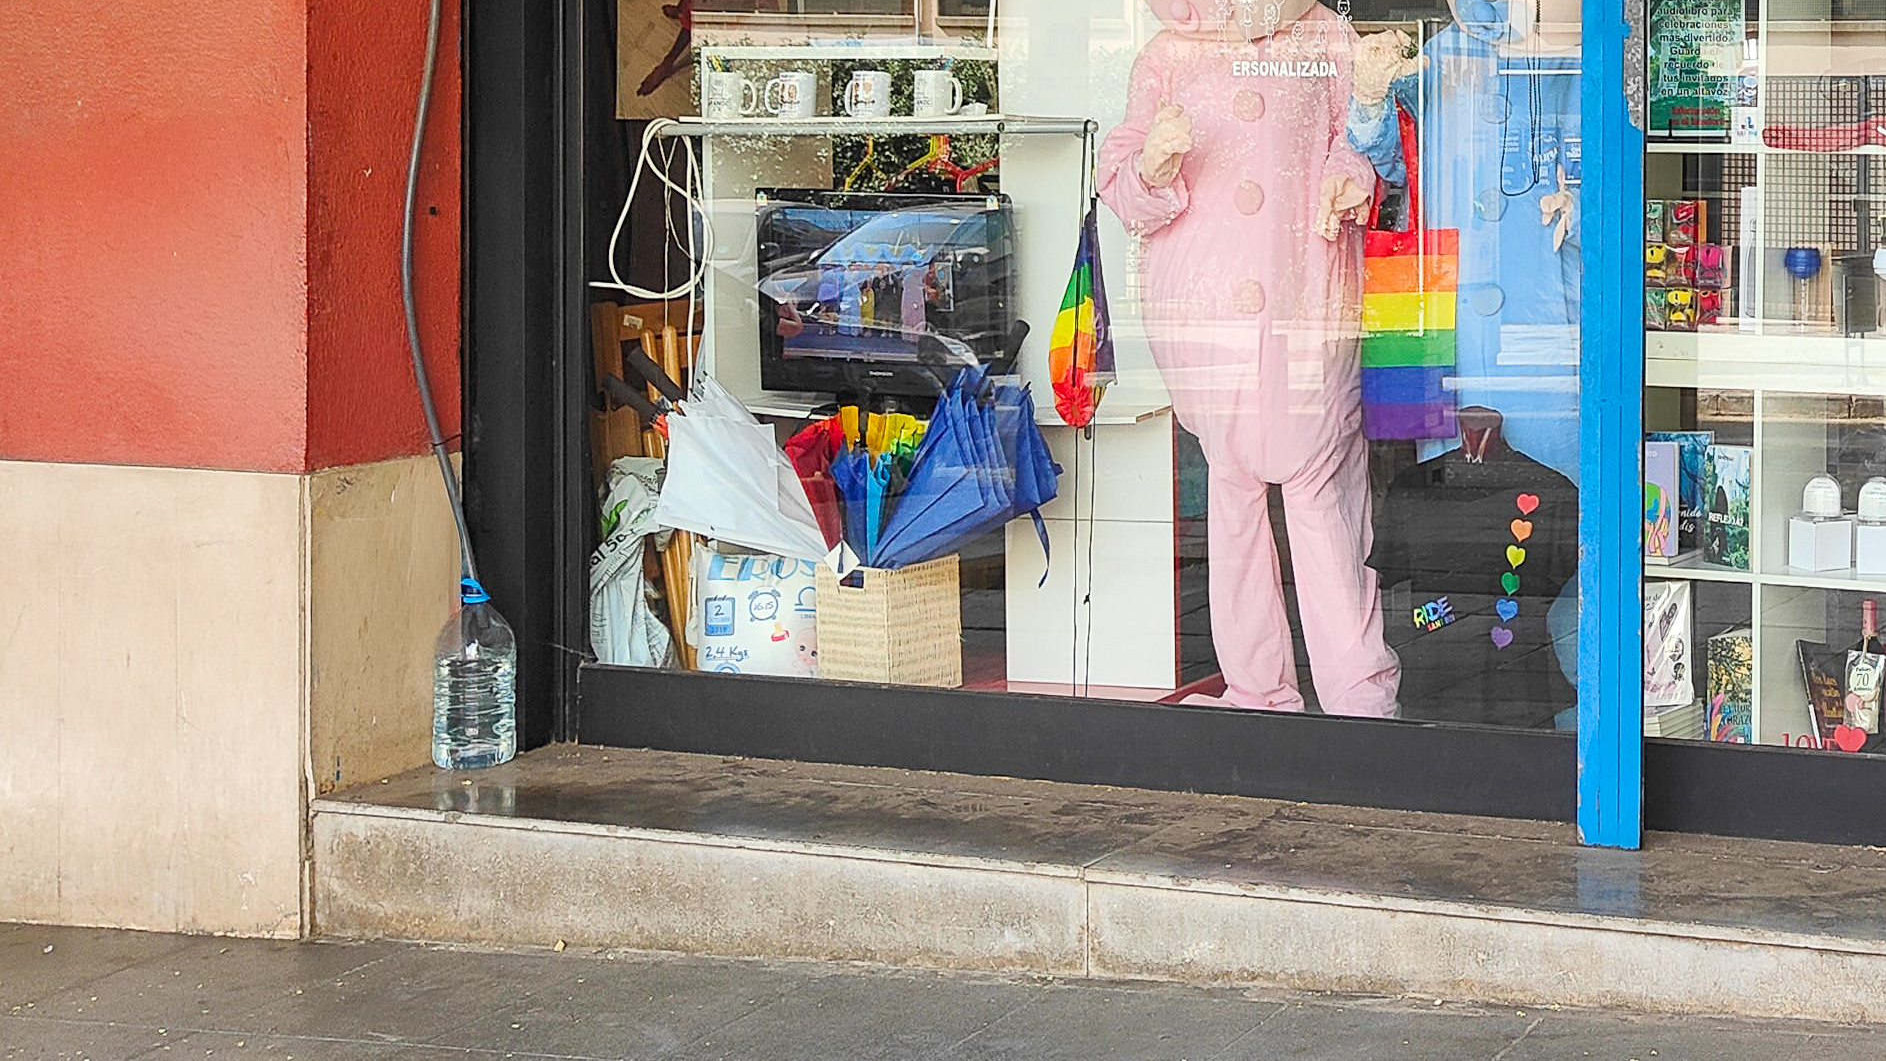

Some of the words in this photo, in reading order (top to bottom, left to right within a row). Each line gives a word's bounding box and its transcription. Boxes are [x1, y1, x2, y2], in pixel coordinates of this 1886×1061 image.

[1657, 7, 1708, 19] audiolibro
[1711, 8, 1734, 17] para
[1658, 20, 1729, 29] celebraciones
[1232, 61, 1338, 77] ERSONALIZADA
[1664, 61, 1709, 70] recuerdo
[1663, 74, 1679, 83] tus
[1676, 88, 1690, 96] un
[714, 605, 725, 616] 2
[1856, 673, 1869, 687] 70
